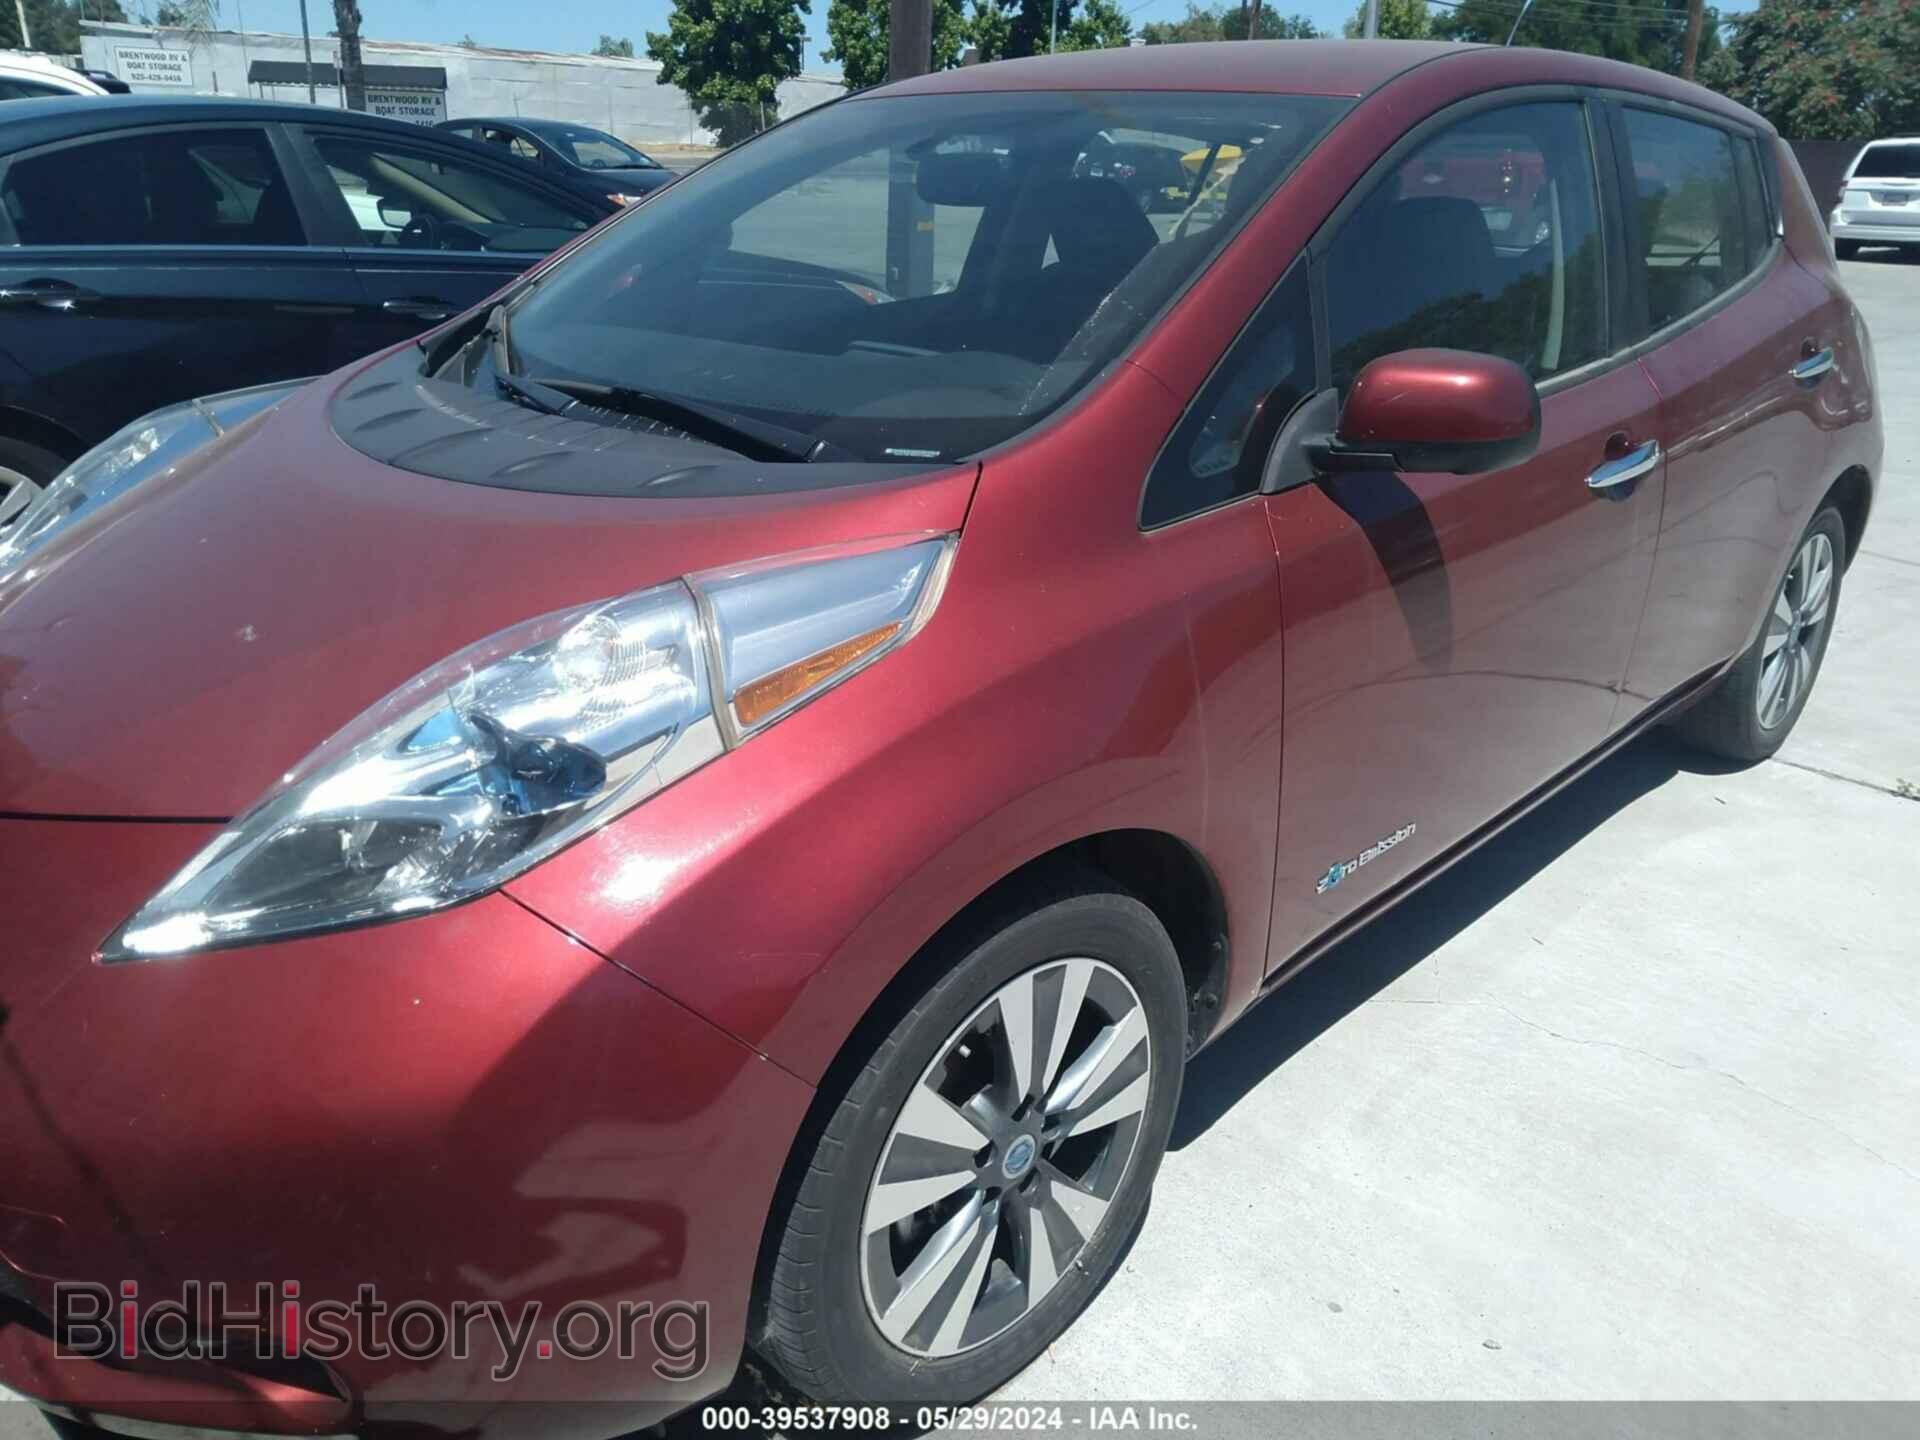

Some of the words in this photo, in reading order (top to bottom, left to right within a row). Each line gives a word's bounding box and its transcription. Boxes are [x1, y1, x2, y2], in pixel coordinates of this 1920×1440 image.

[118, 51, 167, 61] BRENTWOOD
[169, 53, 179, 61] RV
[148, 62, 182, 71] STORAGE
[367, 95, 419, 104] BRENTWOOD
[421, 96, 433, 105] RV
[375, 106, 396, 116] BOAT
[399, 106, 437, 116] STORAGE
[1358, 822, 1416, 867] Emission
